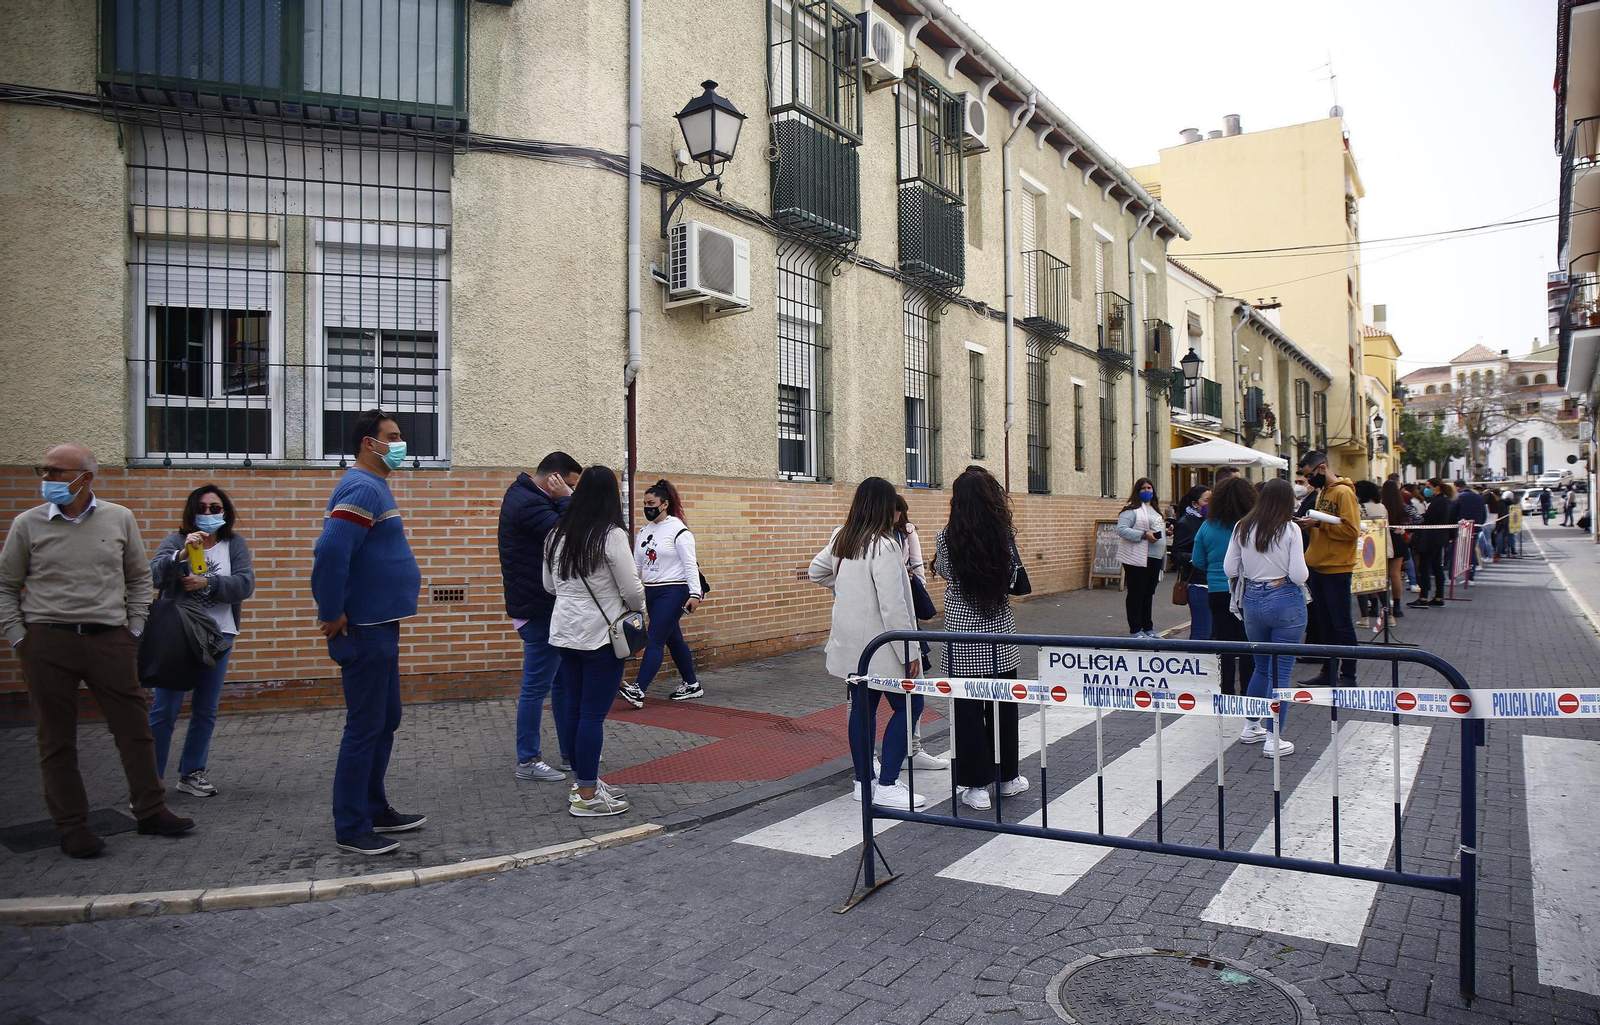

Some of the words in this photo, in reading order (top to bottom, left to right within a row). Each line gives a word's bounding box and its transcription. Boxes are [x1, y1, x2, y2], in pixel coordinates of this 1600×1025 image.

[1104, 546, 1111, 557] Y
[1050, 653, 1128, 672] POLICIA
[1138, 656, 1208, 675] LOCAL
[964, 681, 990, 698] POLICIA
[991, 682, 1013, 700] LOCAL
[1083, 686, 1111, 707] POLICIA
[1112, 687, 1135, 709] LOCAL
[1332, 689, 1366, 709] POLICIA
[1368, 690, 1396, 712] LOCAL
[1213, 694, 1244, 715] POLICIA
[1245, 698, 1270, 716] LOCAL
[1492, 692, 1529, 717] POLICIA
[1530, 692, 1559, 717] LOCAL
